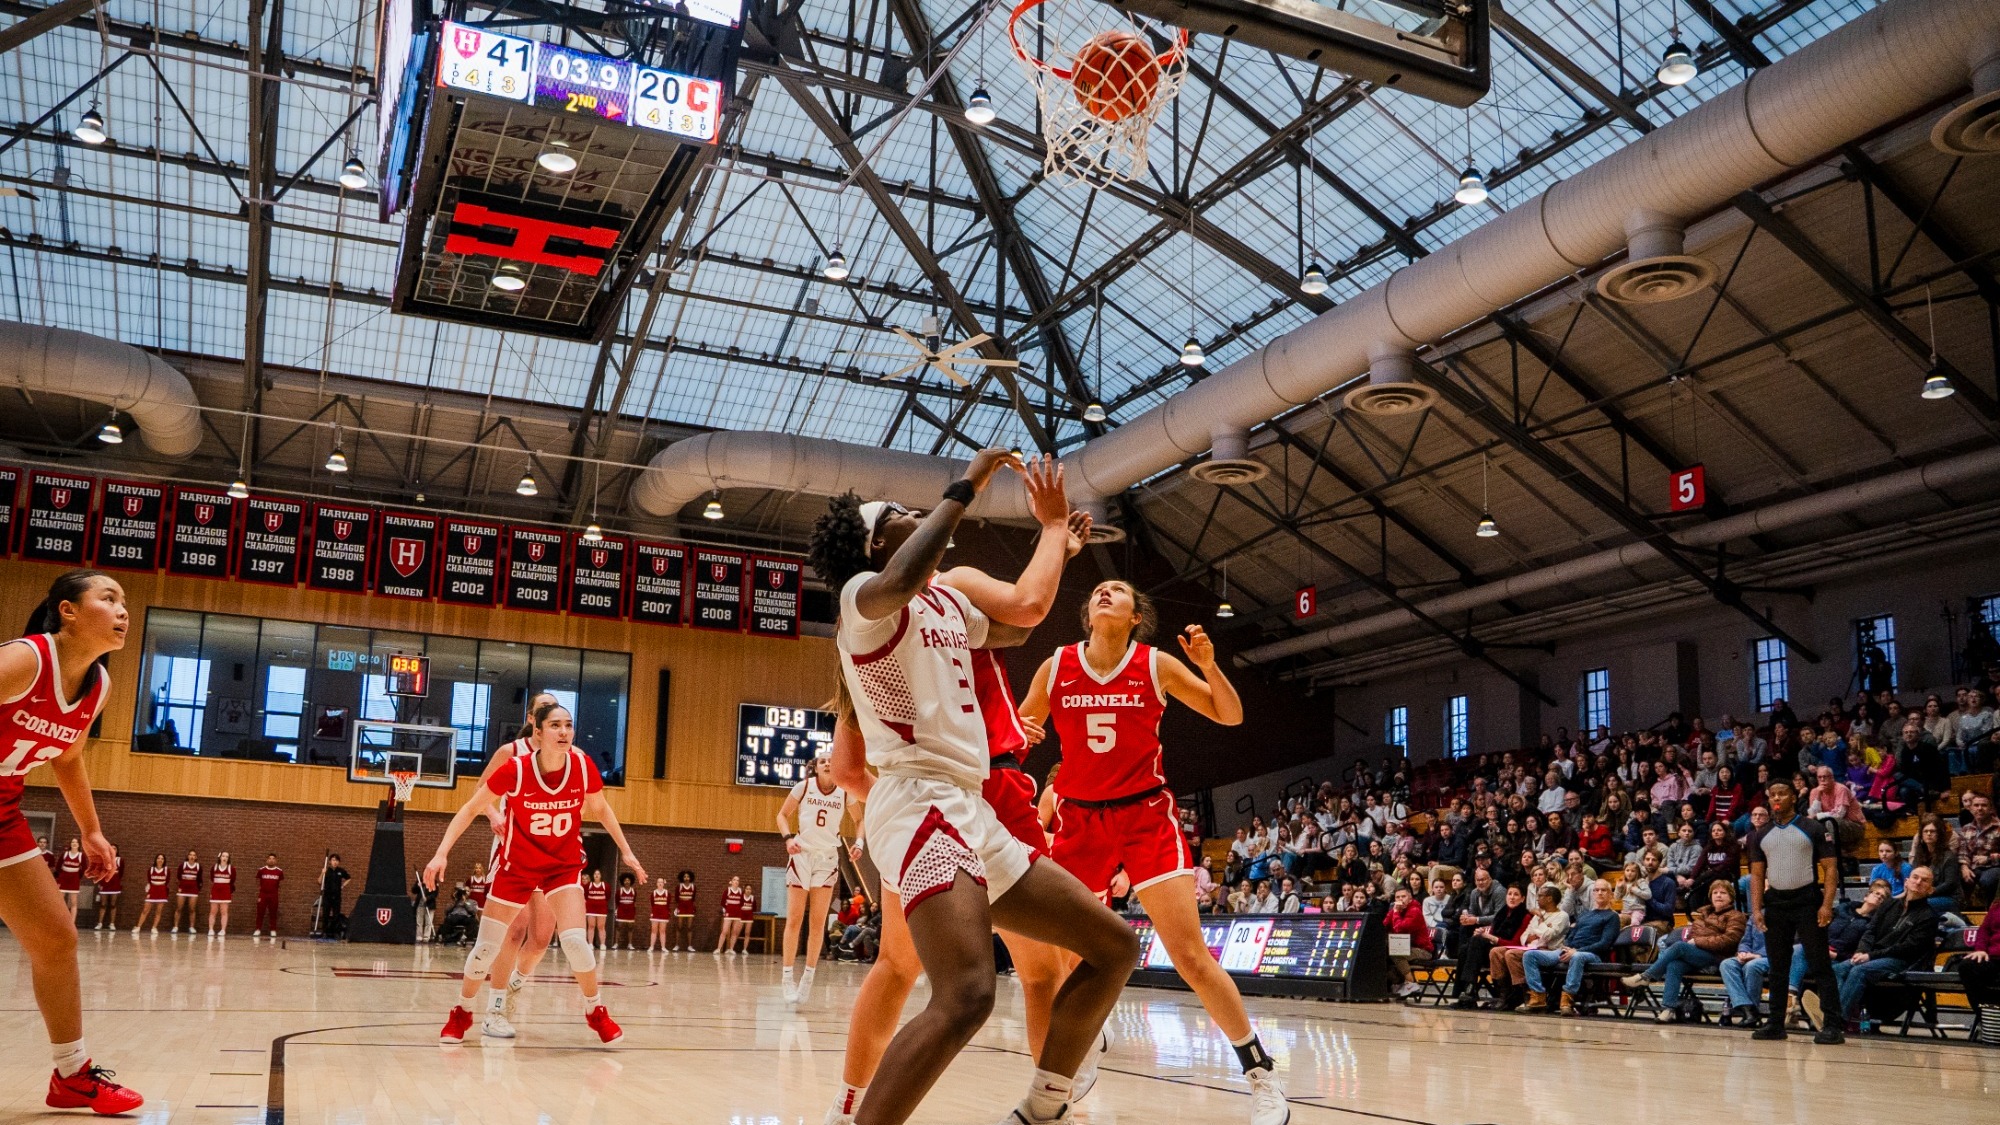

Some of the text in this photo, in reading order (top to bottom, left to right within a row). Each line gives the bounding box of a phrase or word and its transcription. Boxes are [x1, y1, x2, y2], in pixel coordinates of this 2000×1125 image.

[458, 31, 529, 72] H 41
[550, 54, 619, 91] 03.9
[465, 68, 479, 86] 4
[501, 75, 515, 94] 3
[640, 72, 709, 113] 20 C
[565, 92, 597, 112] 2ND
[647, 108, 660, 125] 4
[681, 114, 693, 132] 3
[35, 475, 90, 489] HARVARD
[1678, 473, 1695, 504] 5
[55, 490, 66, 503] H
[108, 484, 161, 497] HARVARD
[127, 499, 138, 511] H
[180, 492, 231, 505] HARVARD
[199, 506, 209, 519] H
[250, 500, 300, 513] HARVARD
[31, 509, 85, 522] IVY LEAGUE
[268, 514, 278, 527] H
[320, 508, 369, 520] HARVARD
[30, 518, 84, 531] CHAMPIONS
[104, 517, 156, 530] IVY LEAGUE
[337, 523, 347, 535] H
[386, 516, 434, 529] HARVARD
[102, 526, 155, 539] CHAMPIONS
[177, 525, 227, 537] IVY LEAGUE
[450, 524, 497, 536] HARVARD
[175, 534, 227, 546] CHAMPIONS
[246, 532, 295, 545] IVY LEAGUE
[515, 531, 560, 543] HARVARD
[36, 537, 72, 552] 1988
[245, 541, 295, 554] CHAMPIONS
[317, 541, 364, 552] IVY LEAGUE
[467, 538, 477, 550] H
[531, 545, 541, 556] H
[578, 538, 623, 550] HARVARD
[110, 545, 143, 559] 1991
[316, 550, 364, 561] CHAMPIONS
[398, 543, 416, 566] H
[595, 552, 604, 563] H
[639, 546, 683, 558] HARVARD
[699, 553, 741, 564] HARVARD
[181, 552, 216, 566] 1996
[447, 555, 493, 567] IVY LEAGUE
[656, 559, 664, 571] H
[756, 560, 798, 571] HARVARD
[251, 559, 284, 573] 1997
[446, 564, 493, 576] CHAMPIONS
[512, 561, 557, 574] IVY LEAGUE
[715, 566, 723, 577] H
[321, 567, 354, 581] 1998
[511, 570, 557, 582] CHAMPIONS
[576, 569, 620, 580] IVY LEAGUE
[772, 573, 780, 584] H
[452, 581, 484, 595] 2002
[575, 577, 620, 589] CHAMPIONS
[638, 576, 680, 588] IVY LEAGUE
[697, 583, 739, 594] IVY LEAGUE
[384, 586, 423, 597] WOMEN
[517, 587, 548, 601] 2003
[636, 584, 680, 596] CHAMPIONS
[696, 591, 739, 602] CHAMPIONS
[755, 590, 796, 600] IVY LEAGUE
[581, 594, 611, 607] 2005
[755, 597, 796, 609] TOURNAMENT
[1299, 591, 1310, 614] 6
[642, 601, 672, 614] 2007
[702, 608, 731, 620] 2008
[753, 605, 796, 616] CHAMPIONS
[760, 618, 788, 631] 2025
[392, 657, 418, 672] 03.8
[1061, 694, 1145, 708] CORNELL
[768, 707, 805, 728] 03.8
[1086, 713, 1116, 753] 5
[747, 737, 770, 755] 41
[784, 740, 796, 756] 2
[773, 757, 793, 765] PLAYER
[745, 761, 755, 776] 3
[760, 765, 769, 775] 4
[774, 764, 792, 779] 40
[523, 798, 580, 810] CORNELL
[807, 798, 842, 810] HARVARD
[530, 812, 573, 837] 20
[816, 809, 827, 827] 6
[379, 909, 388, 921] H
[1235, 927, 1250, 943] 20
[1254, 926, 1264, 943] C
[1632, 927, 1642, 939] H
